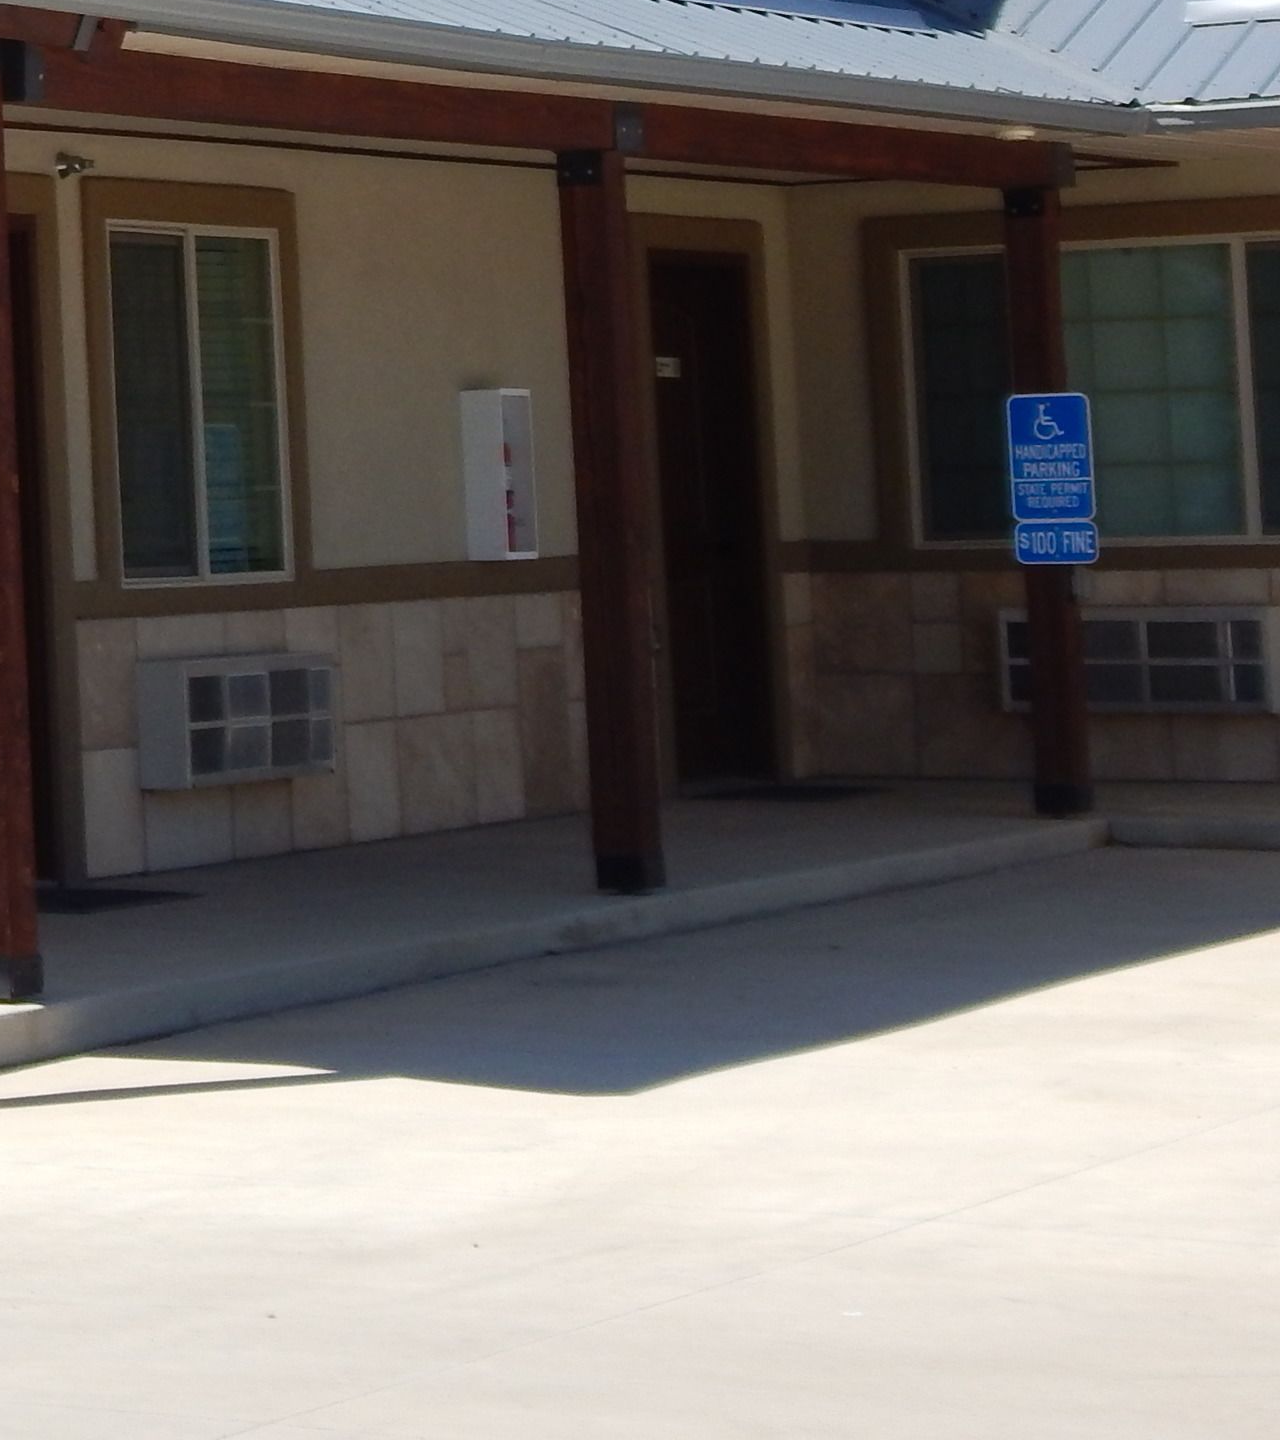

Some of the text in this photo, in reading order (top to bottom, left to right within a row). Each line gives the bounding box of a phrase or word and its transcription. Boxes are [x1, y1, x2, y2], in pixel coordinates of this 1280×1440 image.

[1015, 443, 1087, 460] HANDICAPPED
[1023, 462, 1080, 477] PARKING
[1017, 482, 1089, 496] STATE PERMIT
[1027, 495, 1080, 508] REQUIRED
[1063, 531, 1095, 553] FINE
